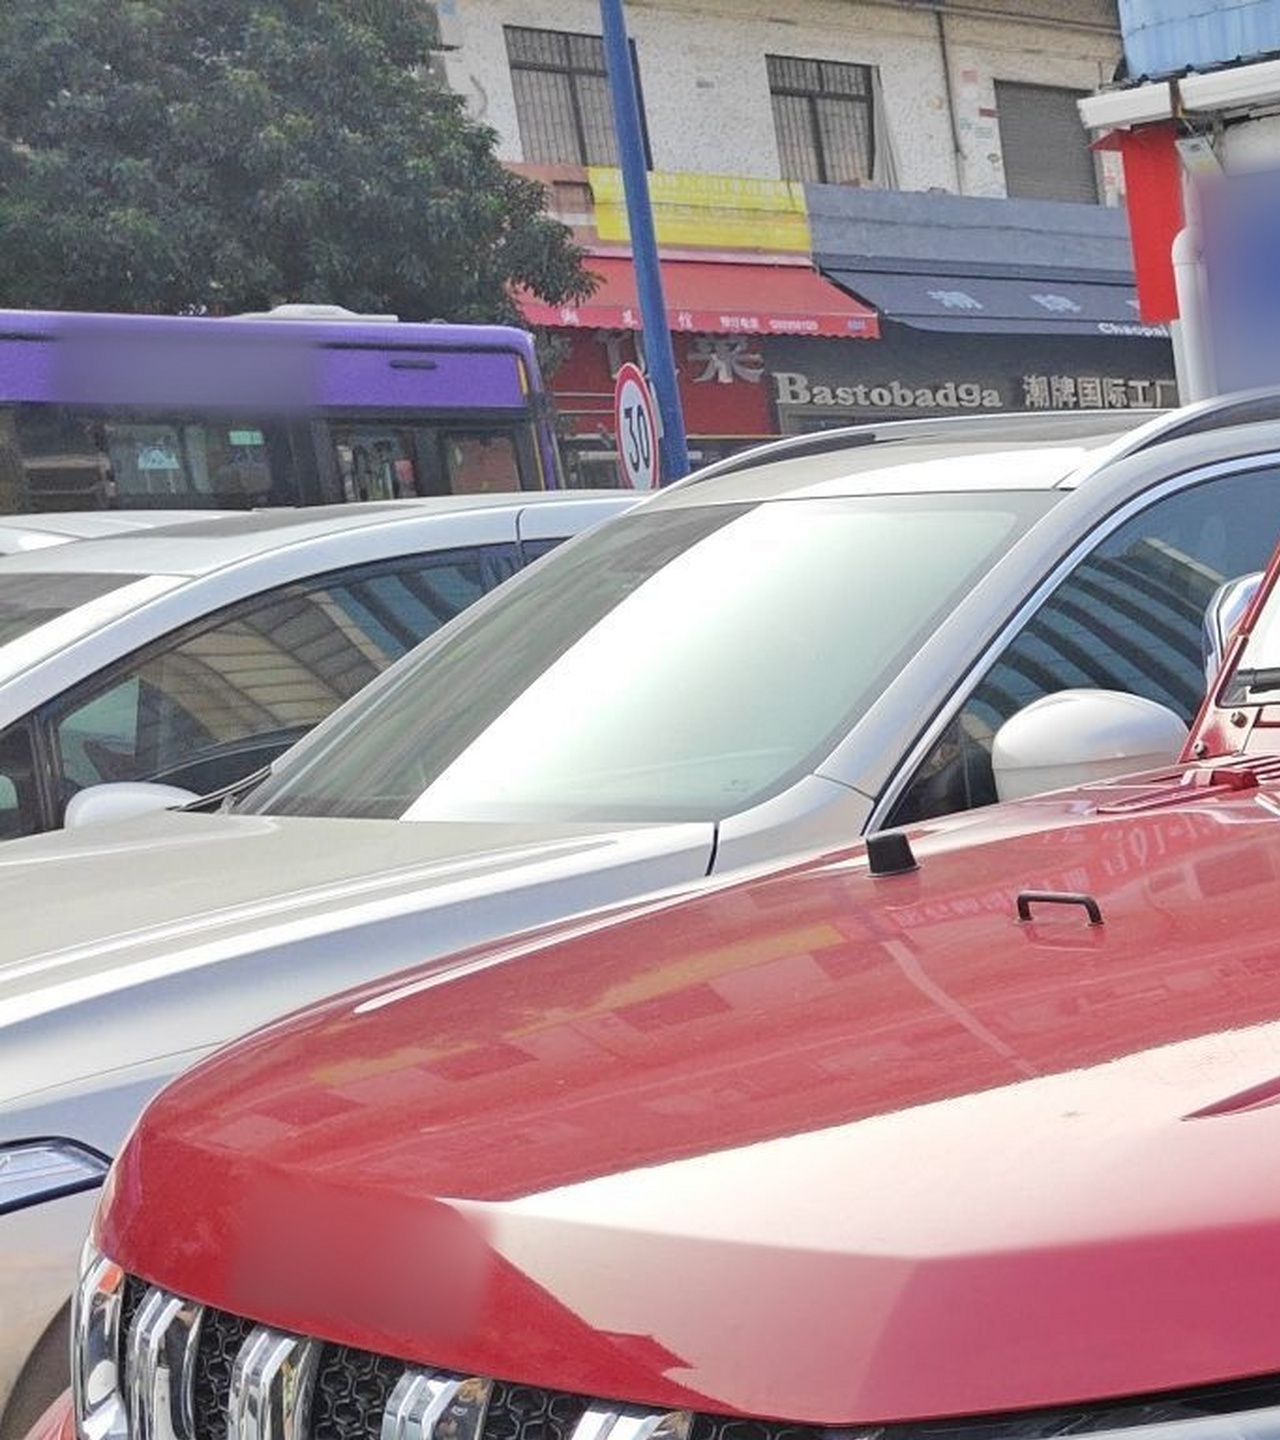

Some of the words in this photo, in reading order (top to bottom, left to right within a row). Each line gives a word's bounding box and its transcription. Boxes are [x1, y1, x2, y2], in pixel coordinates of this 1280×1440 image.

[1021, 374, 1176, 408] 潮牌国际工厂
[624, 404, 650, 473] 30
